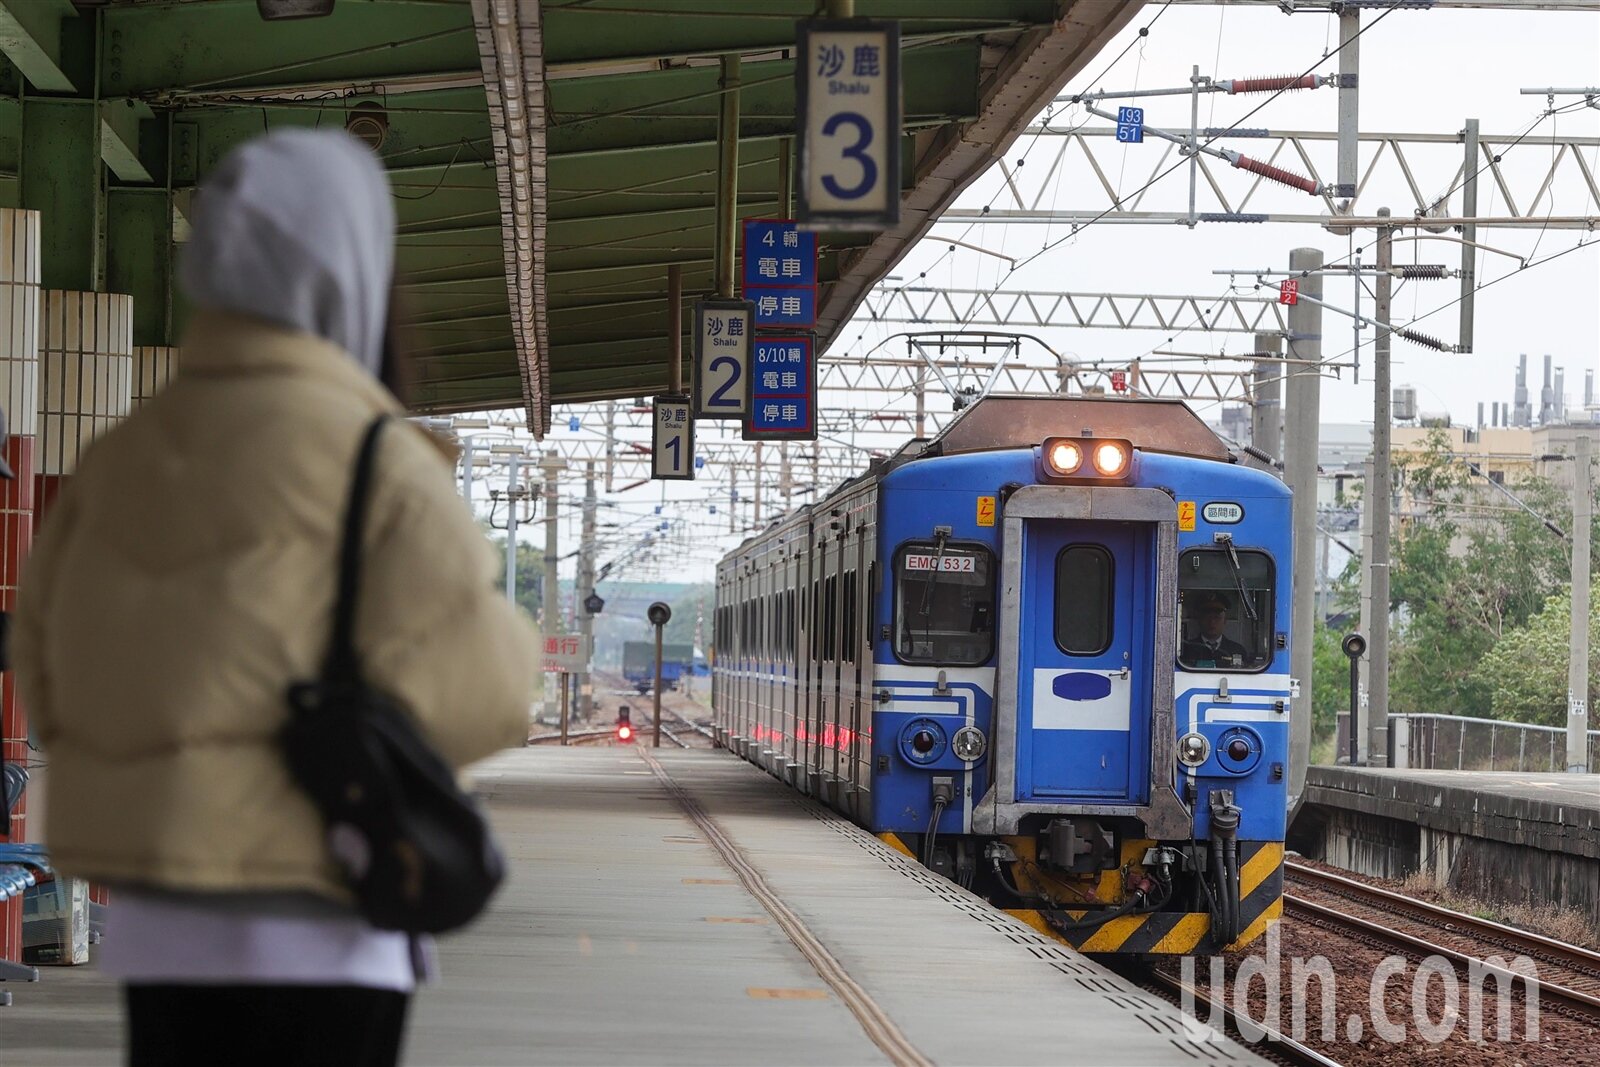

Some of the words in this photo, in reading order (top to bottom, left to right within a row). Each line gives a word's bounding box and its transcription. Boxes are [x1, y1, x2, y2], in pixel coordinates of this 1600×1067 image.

[817, 44, 881, 78] 沙鹿
[828, 79, 870, 95] Shalu
[1120, 108, 1141, 123] 193
[1119, 127, 1136, 141] 51
[821, 112, 877, 200] 3
[762, 230, 774, 247] 4
[783, 231, 798, 248] 輛
[757, 256, 802, 278] 電車
[757, 295, 802, 317] 停車
[1285, 294, 1292, 303] 2
[707, 317, 743, 336] 沙鹿
[713, 337, 738, 346] Shalu
[758, 347, 786, 364] 8/10
[788, 348, 801, 363] 輛
[708, 356, 742, 407] 2
[762, 371, 797, 389] 電車
[661, 408, 687, 422] 沙鹿
[763, 404, 798, 422] 停車
[665, 435, 680, 471] 1
[1208, 507, 1238, 518] 區間車
